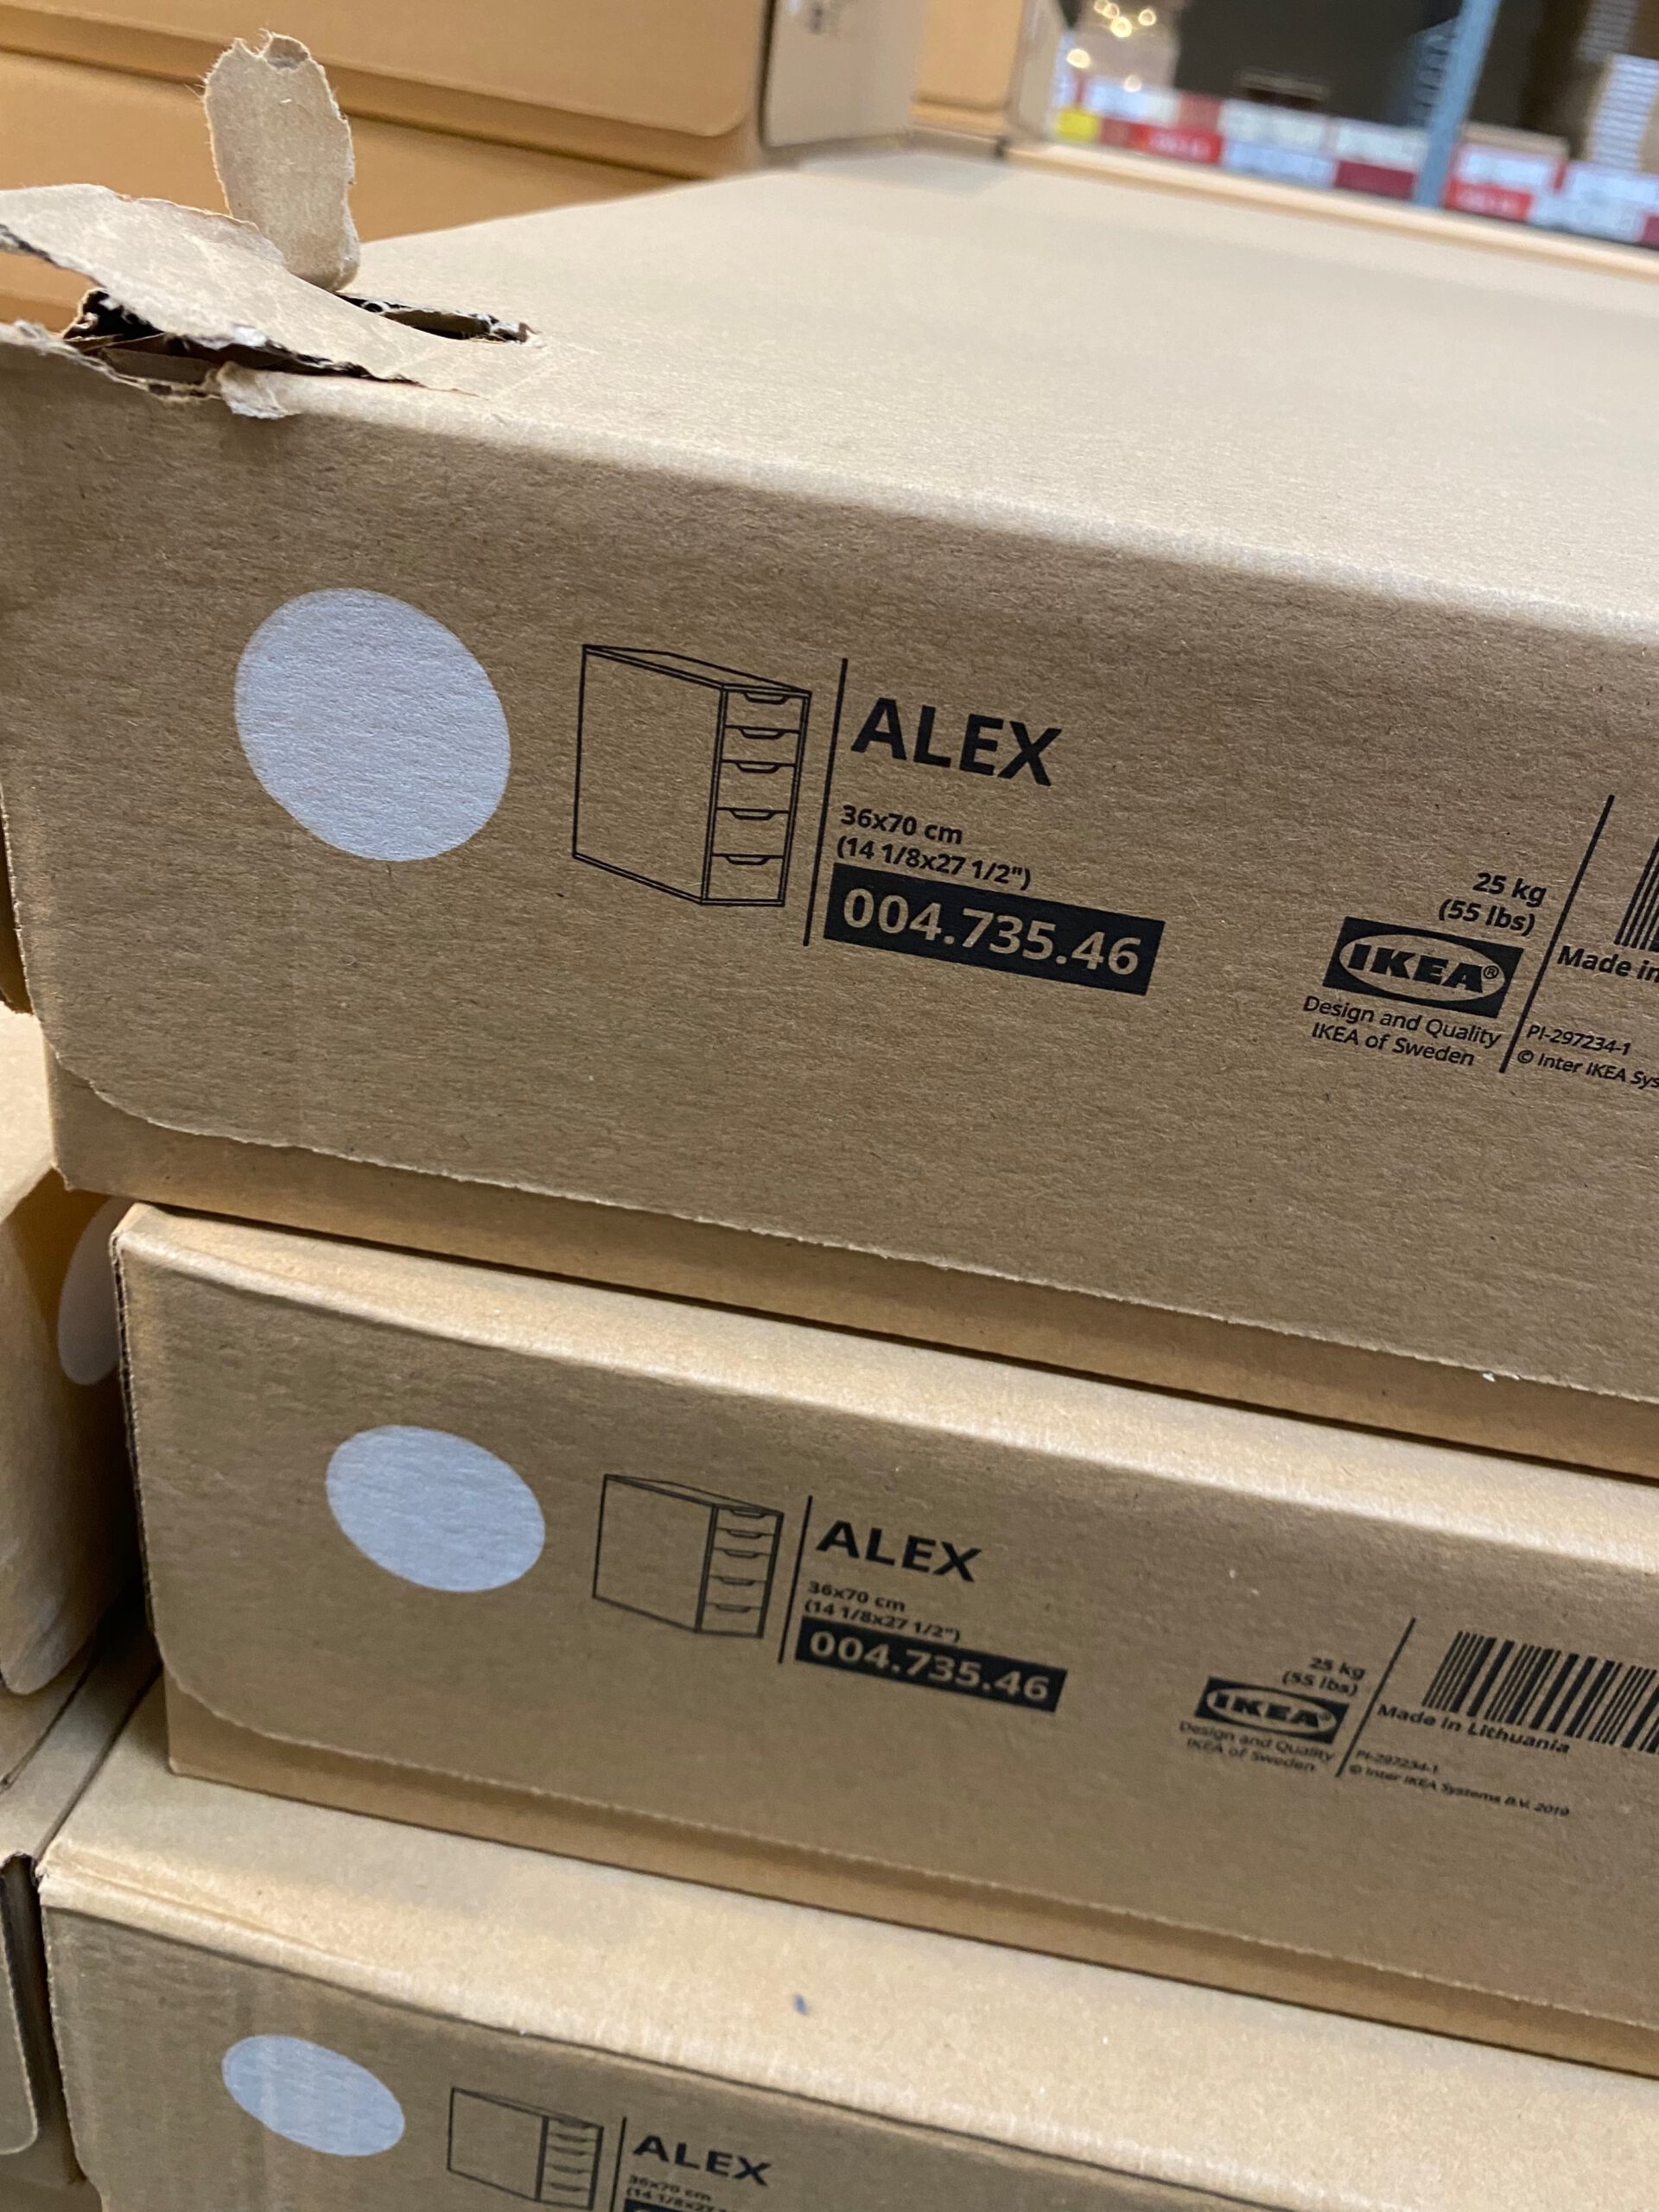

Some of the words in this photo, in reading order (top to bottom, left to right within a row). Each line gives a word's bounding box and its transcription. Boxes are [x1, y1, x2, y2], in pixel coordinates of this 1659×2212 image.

[851, 697, 1063, 786] ALEX
[840, 804, 918, 836] 36x70
[924, 824, 963, 844] cm
[836, 836, 874, 859] (14
[881, 843, 966, 875] 1/8x27
[971, 860, 1032, 891] 1/2")
[1472, 872, 1507, 894] 25
[1511, 878, 1547, 906] kg
[843, 888, 1141, 975] 004.735.46
[1438, 899, 1479, 921] (55
[1484, 906, 1535, 937] lbs)
[1557, 945, 1631, 976] Made
[1637, 960, 1659, 982] in
[1302, 995, 1376, 1023] Design
[1379, 1011, 1421, 1032] and
[1426, 1019, 1501, 1049] Quality
[1527, 1025, 1631, 1056] PI-297234-1
[1312, 1022, 1359, 1046] IKEA
[1364, 1034, 1386, 1050] of
[1392, 1039, 1474, 1066] Sweden
[1537, 1053, 1583, 1072] Inter
[1586, 1062, 1626, 1082] IKEA
[816, 1520, 982, 1582] ALEX
[804, 1599, 835, 1615] (14
[842, 1606, 907, 1630] 1/8x27
[808, 1580, 868, 1604] 36x70
[874, 1597, 906, 1612] cm
[810, 1631, 1049, 1700] 004.735.46
[1282, 1671, 1315, 1685] (55
[1319, 1678, 1357, 1697] lbs)
[1309, 1657, 1333, 1670] 25
[1339, 1662, 1365, 1680] kg
[1179, 1720, 1235, 1741] Design
[1239, 1733, 1273, 1747] and
[1276, 1739, 1335, 1763] Quality
[1377, 1704, 1435, 1726] Made
[1441, 1717, 1462, 1732] in
[1467, 1720, 1570, 1753] Lithuania
[1187, 1737, 1223, 1754] IKEA
[1229, 1744, 1247, 1758] of
[1253, 1751, 1315, 1771] Sweden
[1364, 1767, 1401, 1782] Inter
[1402, 1775, 1437, 1789] IKEA
[1442, 1782, 1501, 1806] Systems
[1535, 1802, 1570, 1816] 2019
[632, 2135, 772, 2187] ALEX
